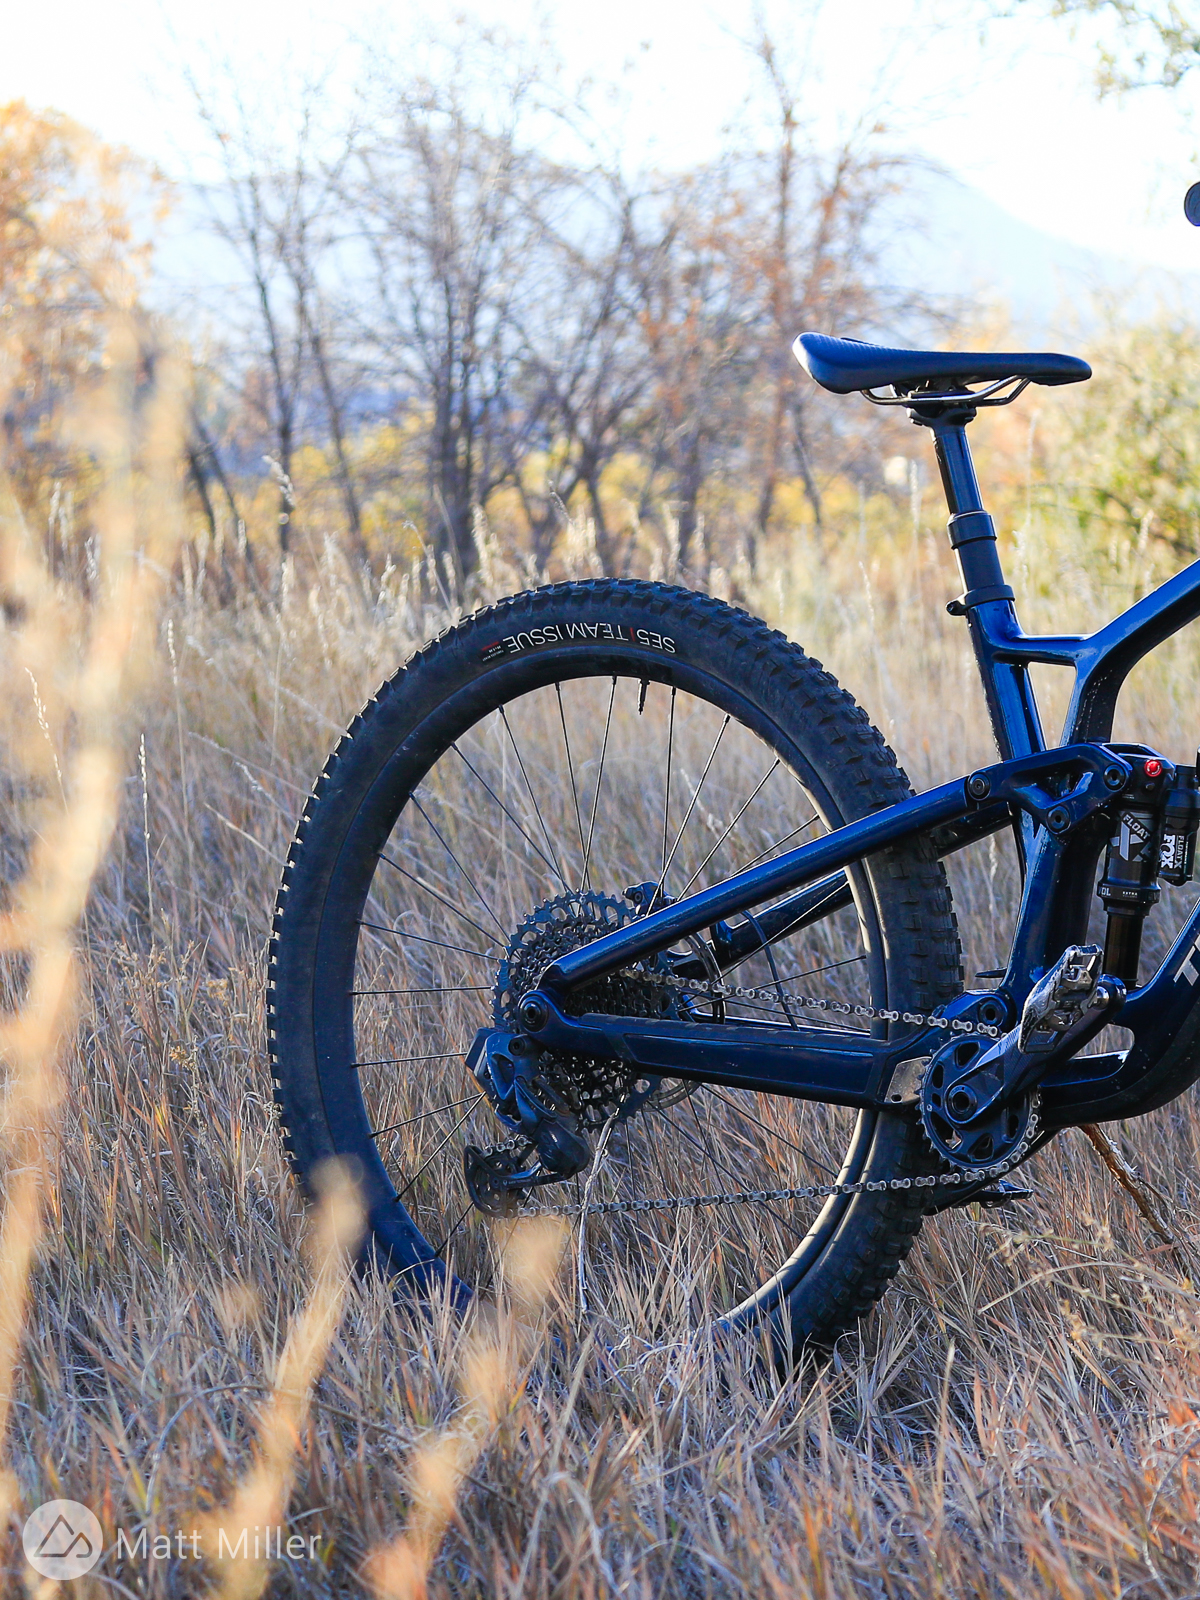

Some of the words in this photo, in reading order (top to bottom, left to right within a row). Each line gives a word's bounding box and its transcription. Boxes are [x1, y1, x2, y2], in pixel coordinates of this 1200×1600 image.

[502, 626, 564, 654] ISSUE
[565, 622, 629, 641] TEAM
[636, 629, 676, 654] SE5
[1123, 814, 1150, 840] FLOAT
[1159, 834, 1176, 869] FOX
